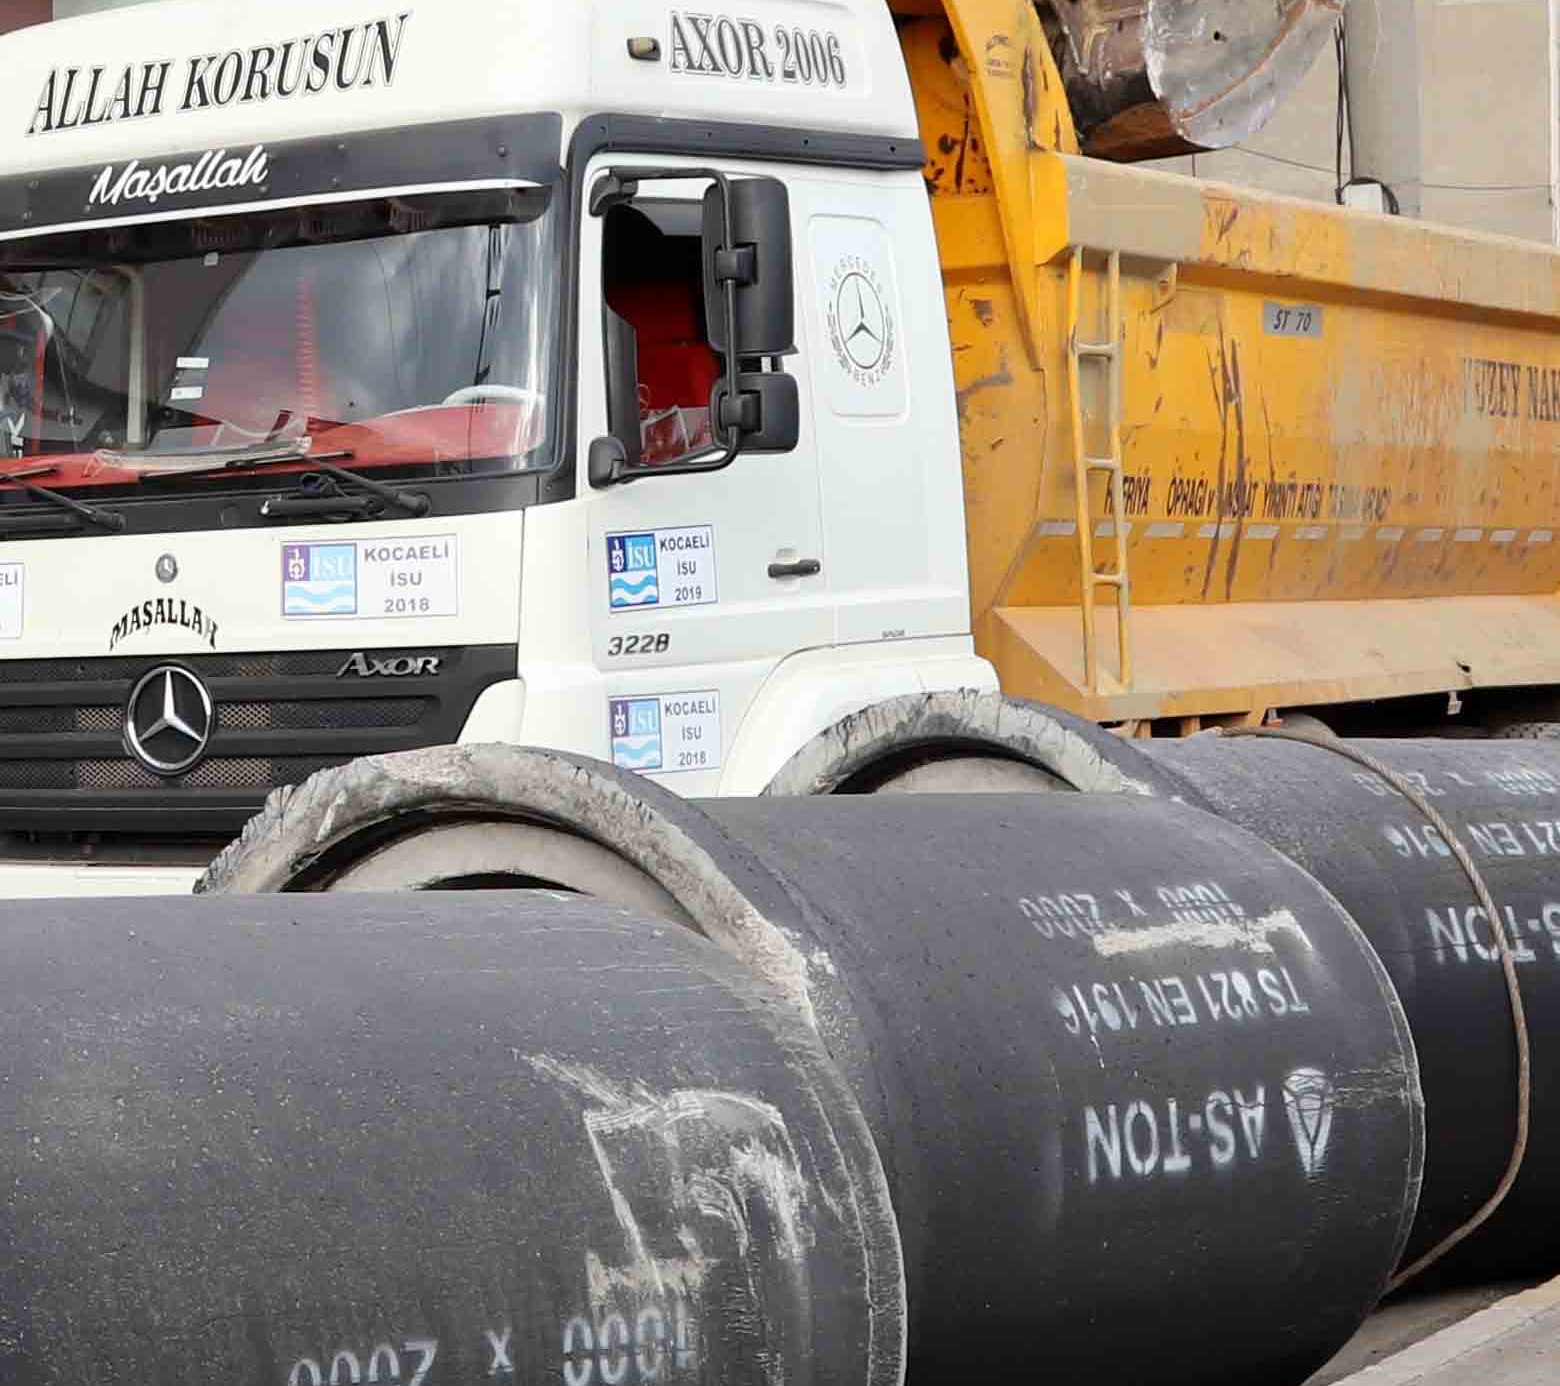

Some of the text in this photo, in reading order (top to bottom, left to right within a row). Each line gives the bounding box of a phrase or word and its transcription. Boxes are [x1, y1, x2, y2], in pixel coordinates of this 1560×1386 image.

[671, 11, 846, 88] AXOR 2006
[25, 11, 411, 135] ALLAH KORUSUN
[88, 144, 269, 205] Maşallah
[1272, 308, 1290, 330] ST
[659, 531, 711, 551] KOCAELİ
[364, 542, 450, 563] KOCAELİ
[390, 567, 423, 587] İSU
[677, 559, 697, 575] İSU
[383, 597, 430, 614] 2018
[675, 587, 703, 602] 2019
[108, 597, 218, 652] MAŞALLAH
[664, 699, 716, 716] KOCAELİ
[681, 726, 702, 741] İSU
[679, 752, 707, 765] 2018
[1383, 823, 1463, 858] 916
[1467, 822, 1526, 856] EN
[1256, 965, 1312, 1013] TS
[1139, 977, 1199, 1025] EN
[1084, 1083, 1266, 1185] AS-TON
